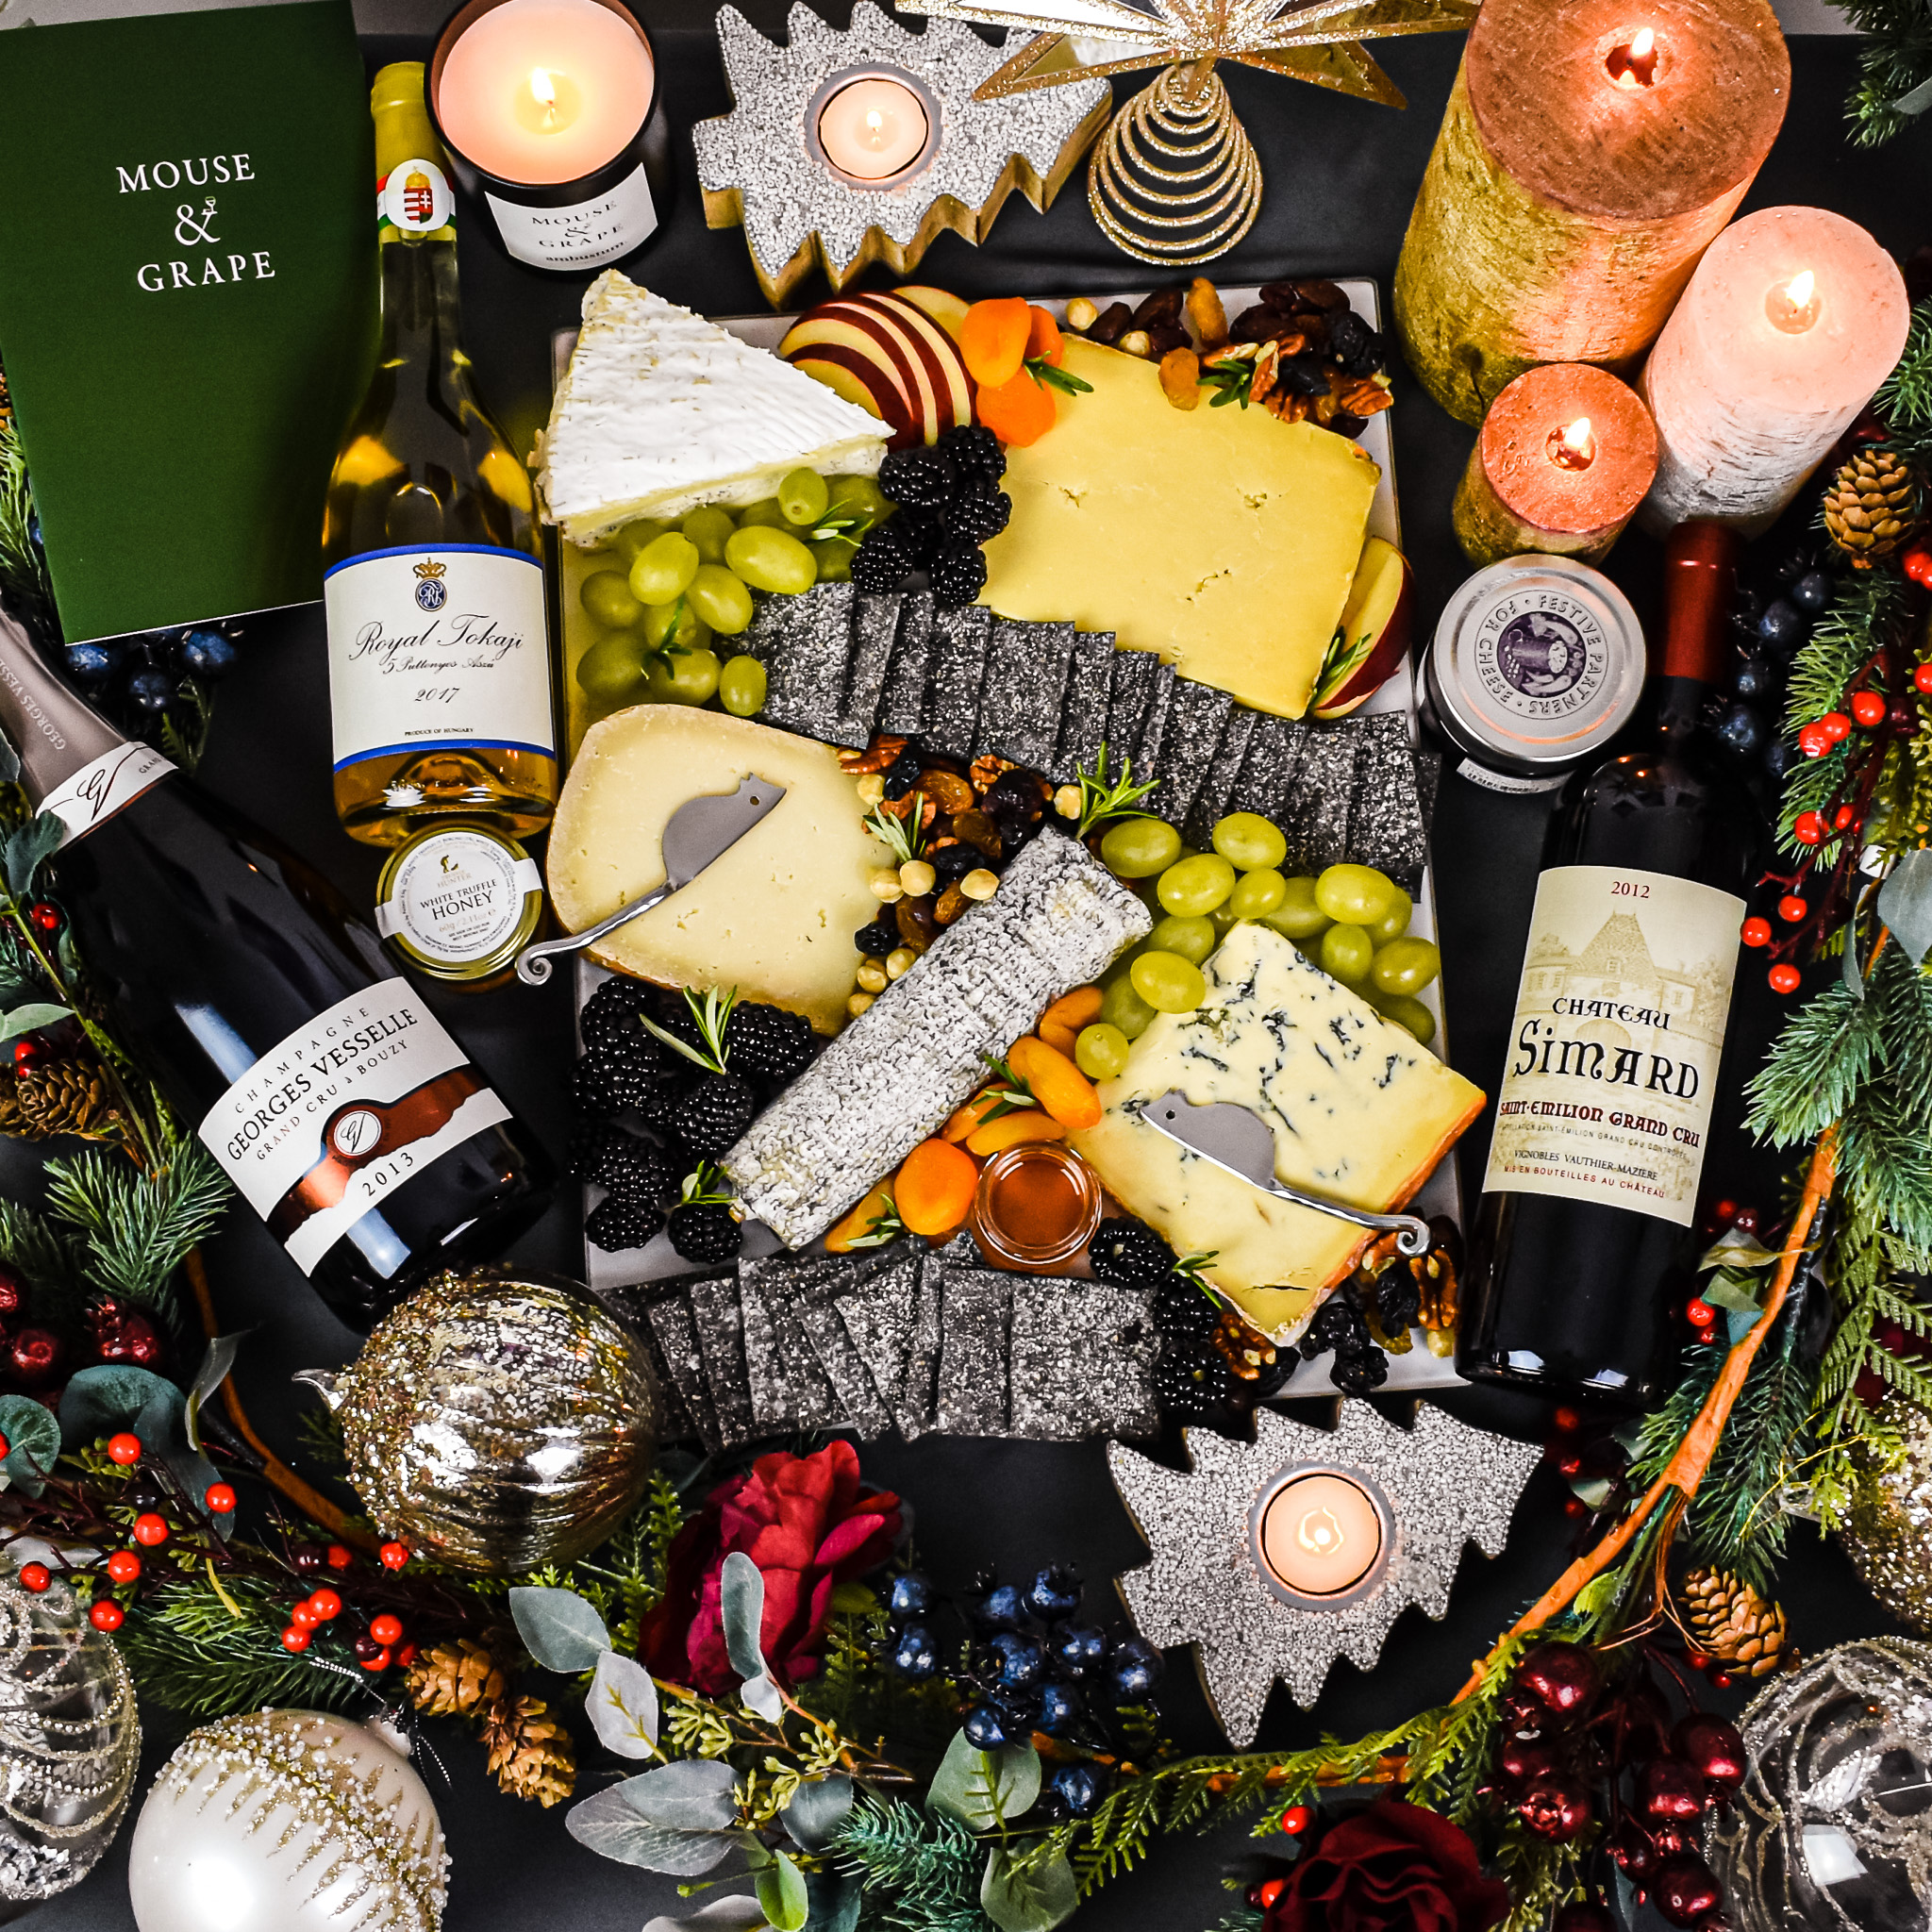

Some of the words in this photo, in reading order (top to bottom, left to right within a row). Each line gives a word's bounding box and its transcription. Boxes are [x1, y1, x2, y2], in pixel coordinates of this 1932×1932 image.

[116, 153, 256, 193] MOUSE
[175, 202, 222, 246] &
[532, 200, 617, 225] MOUSE
[540, 224, 624, 247] GRAPE
[137, 251, 276, 292] GRAPE
[1485, 599, 1520, 633] FOR
[1539, 593, 1603, 646] FESTIVE
[349, 619, 441, 666] Royal
[437, 614, 525, 660] Tokaji
[382, 658, 396, 675] 5
[1478, 637, 1515, 704] CHEESE
[1528, 652, 1604, 715] PARTNERS
[413, 687, 461, 704] 2017
[20, 694, 66, 750] GEORGES
[420, 892, 454, 909] WHITE
[456, 878, 498, 898] TRUFFLE
[432, 890, 492, 921] HONEY
[1610, 880, 1652, 899] 2012
[1552, 996, 1671, 1031] CHATEAU
[235, 1007, 370, 1115] CHAMPAGNE
[226, 1073, 312, 1161] GEORGES
[310, 1008, 419, 1077] VESSELLE
[257, 1115, 301, 1161] GRAND
[306, 1084, 340, 1114] CRU
[357, 1039, 409, 1076] BOUZY
[1608, 1111, 1669, 1137] GRAND
[1673, 1126, 1701, 1148] CRU
[361, 1151, 415, 1197] 2013
[1514, 1149, 1560, 1162] VIGNOBLES
[1519, 1165, 1530, 1174] EN
[1533, 1167, 1597, 1183] BOUTEILLES
[1601, 1177, 1615, 1187] AU
